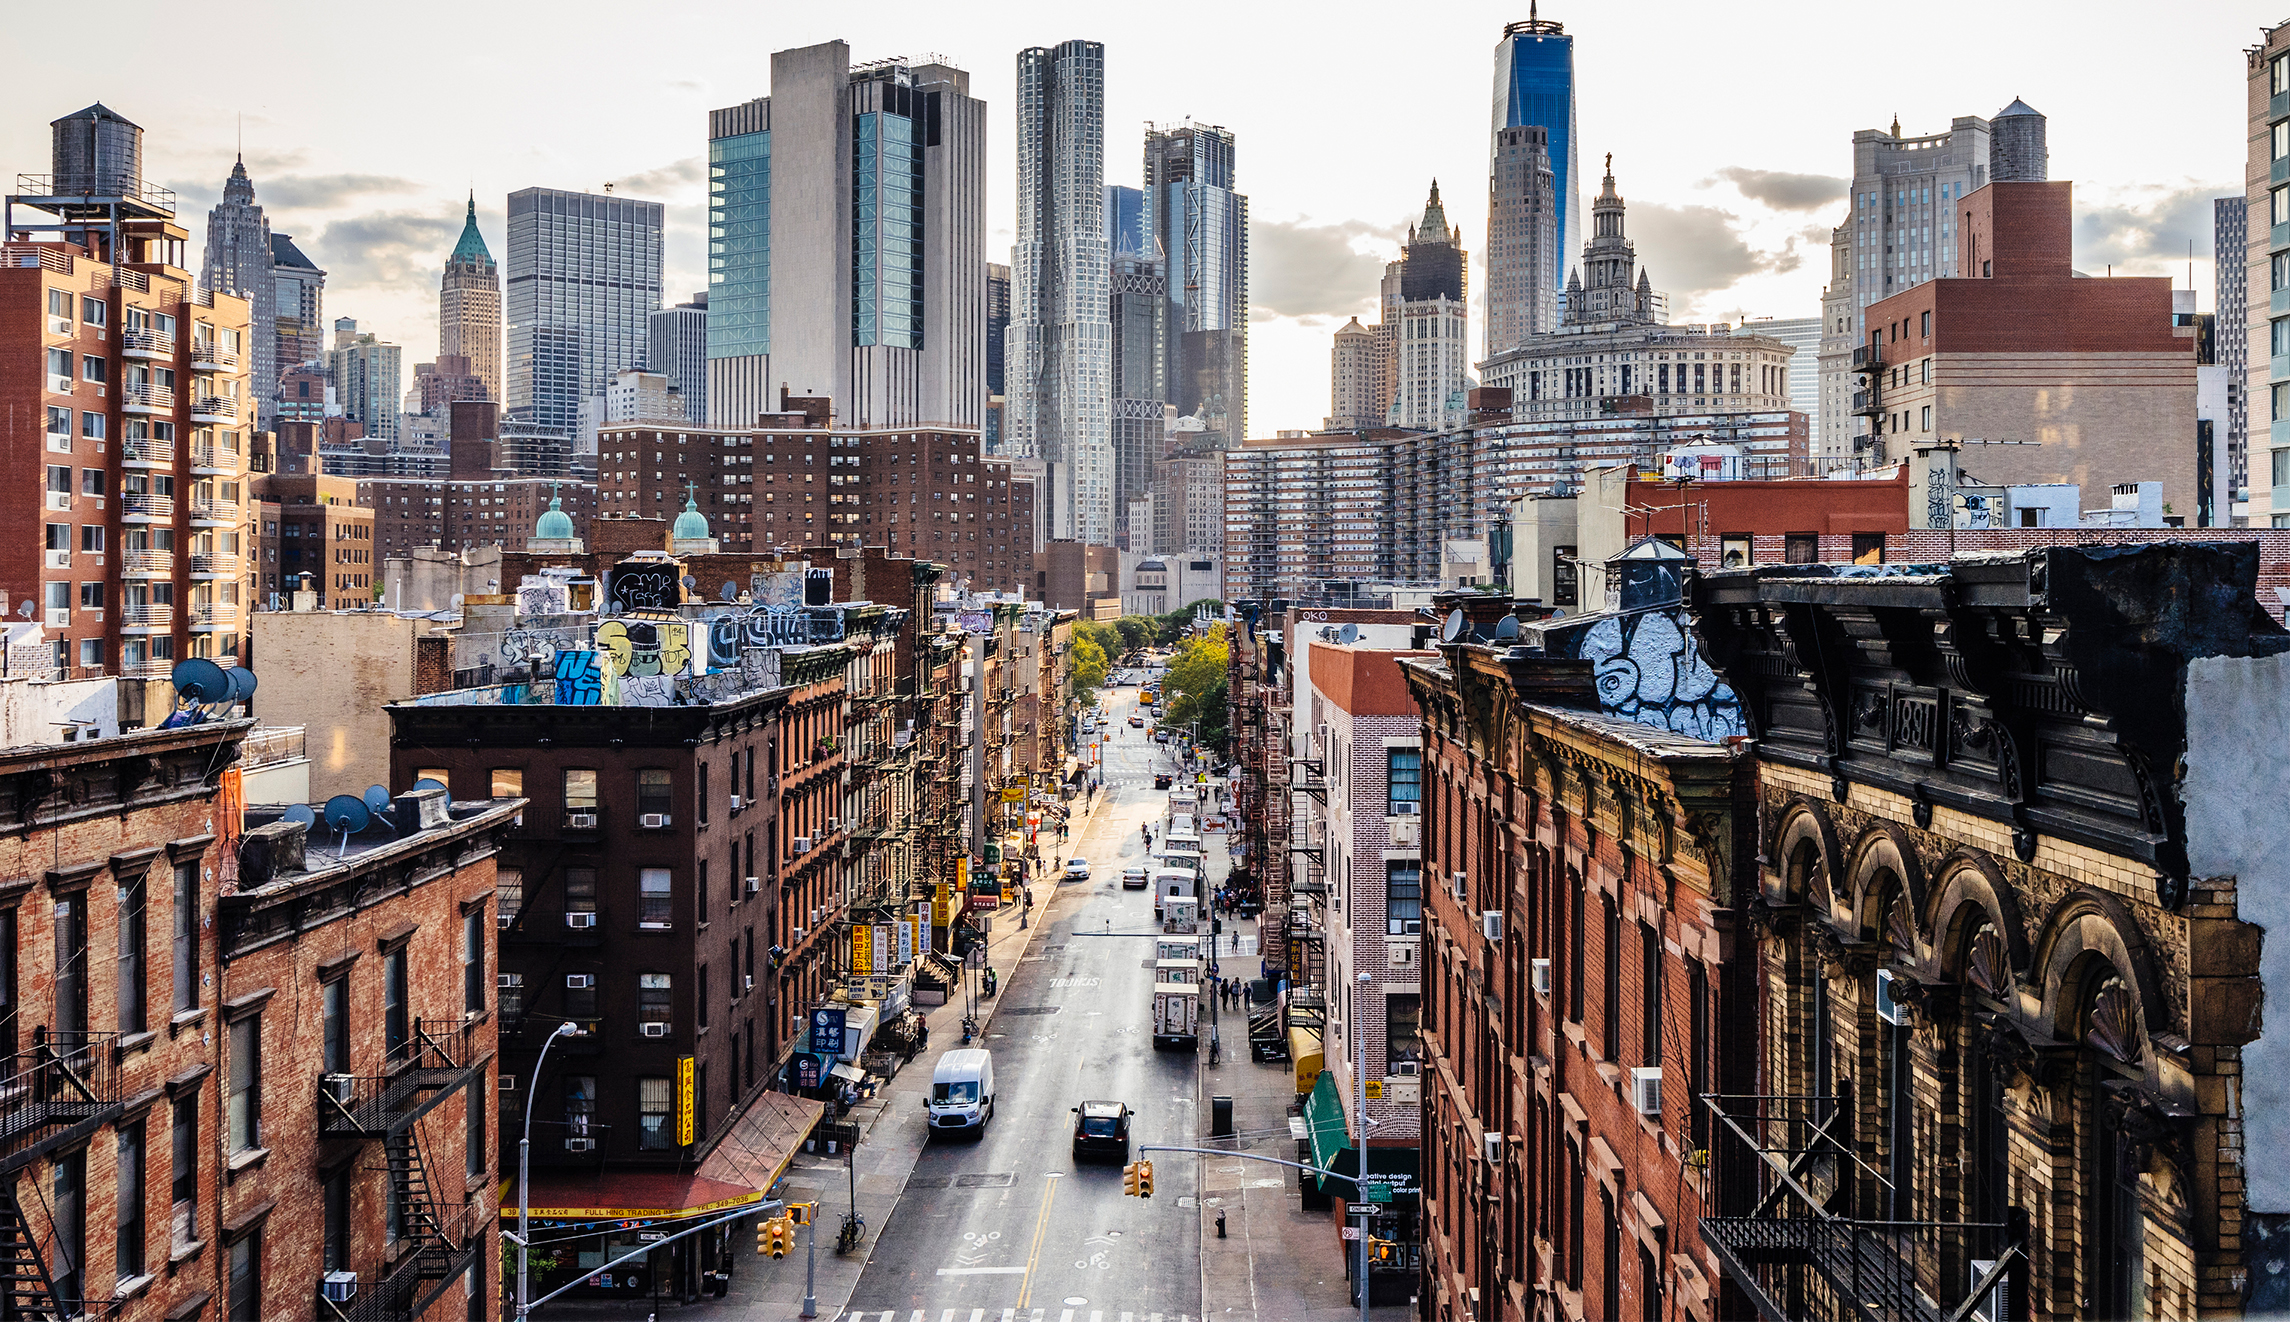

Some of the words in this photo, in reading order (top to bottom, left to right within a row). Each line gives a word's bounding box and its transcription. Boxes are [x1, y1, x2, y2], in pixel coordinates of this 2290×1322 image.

[1388, 1173, 1412, 1181] design
[715, 1195, 749, 1209] 349-7036
[627, 1209, 661, 1217] TRADING
